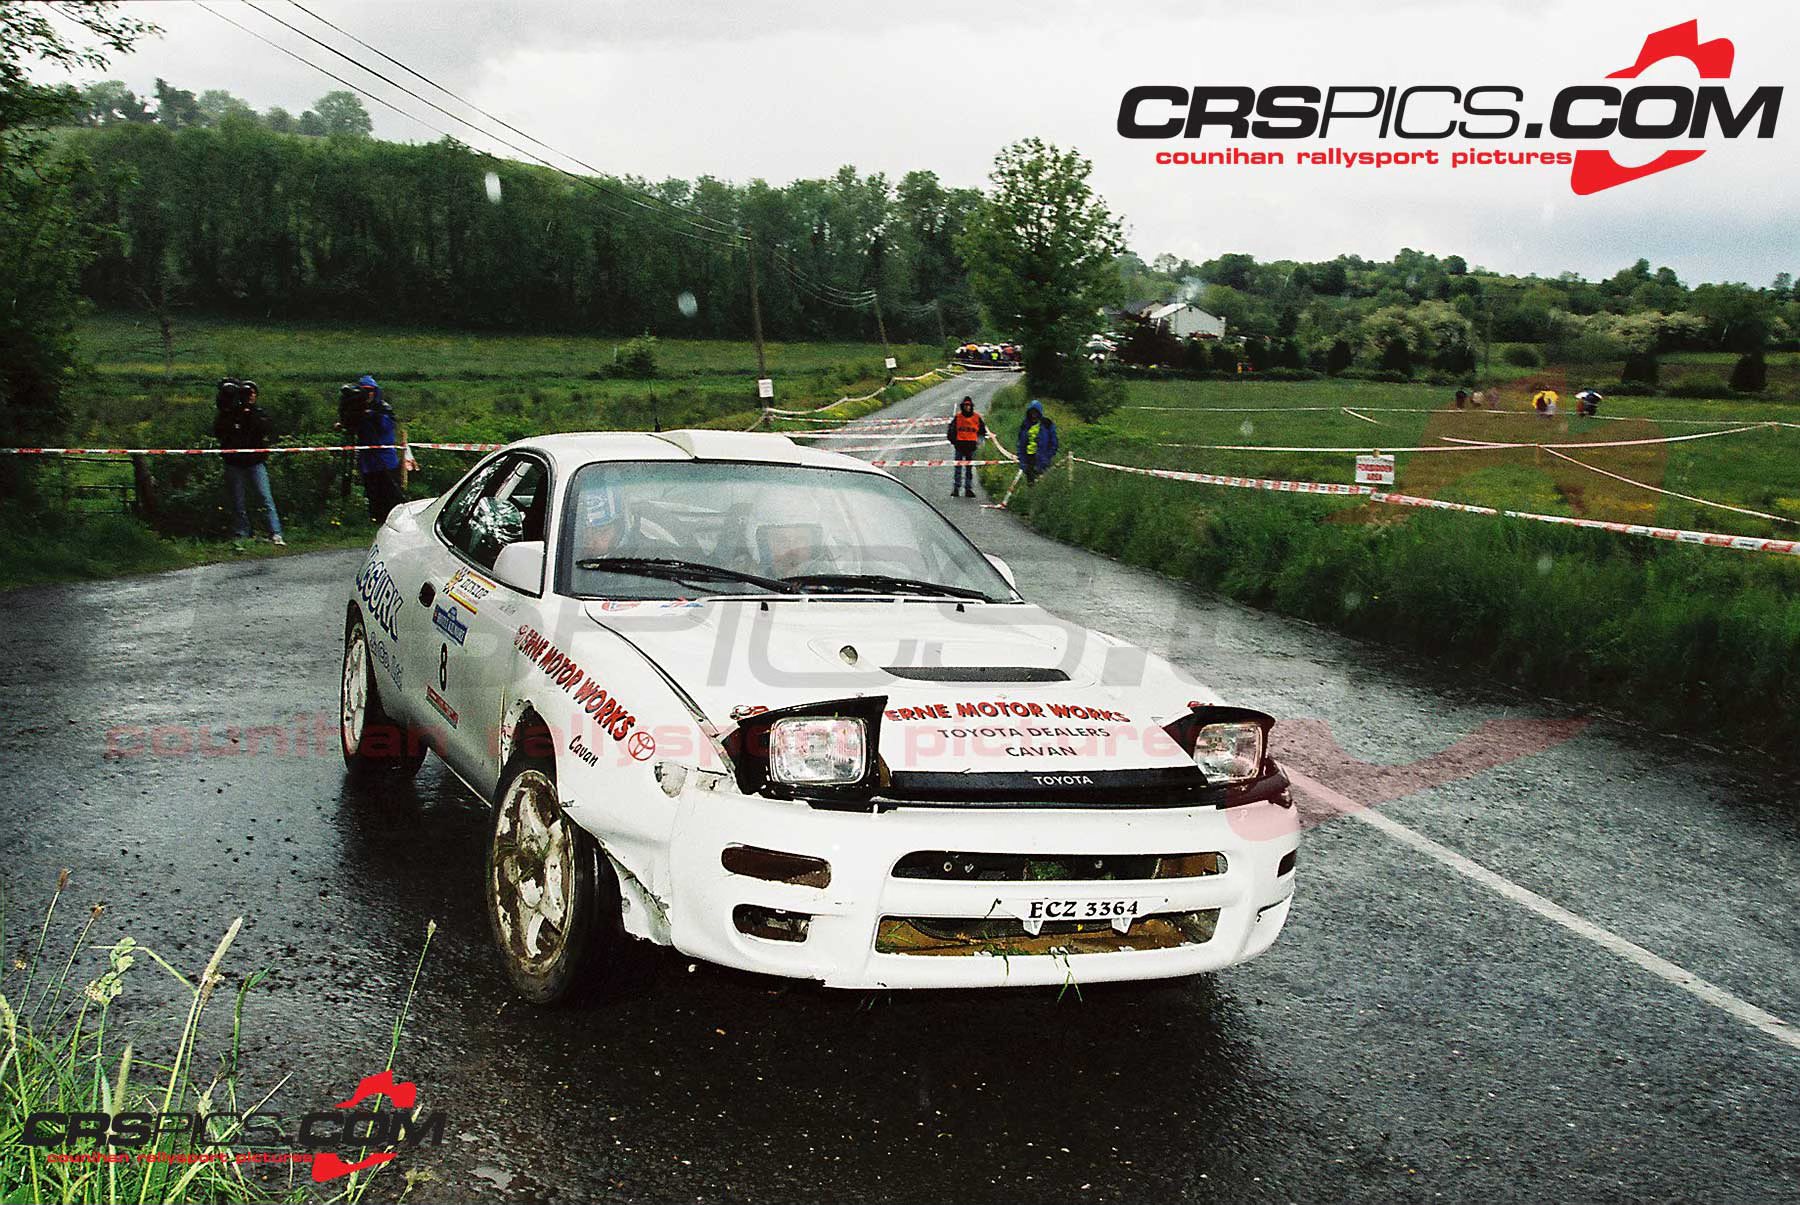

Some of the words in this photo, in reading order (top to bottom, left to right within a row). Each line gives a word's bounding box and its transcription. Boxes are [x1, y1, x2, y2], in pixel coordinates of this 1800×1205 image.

[440, 642, 448, 692] 8
[519, 628, 550, 663] ERNE
[537, 646, 585, 693] MOTOR
[572, 677, 636, 742] WORKS
[885, 703, 952, 721] ERNE
[956, 701, 1047, 718] MOTOR
[1047, 703, 1131, 723] WORKS
[937, 728, 1022, 739] TOYOTA
[1028, 727, 1110, 738] DEALERS
[568, 734, 599, 768] Cavan
[1005, 746, 1077, 757] CAVAN
[1033, 775, 1094, 785] TOYOTA
[1028, 901, 1077, 919] ECZ
[1085, 900, 1139, 917] 3364
